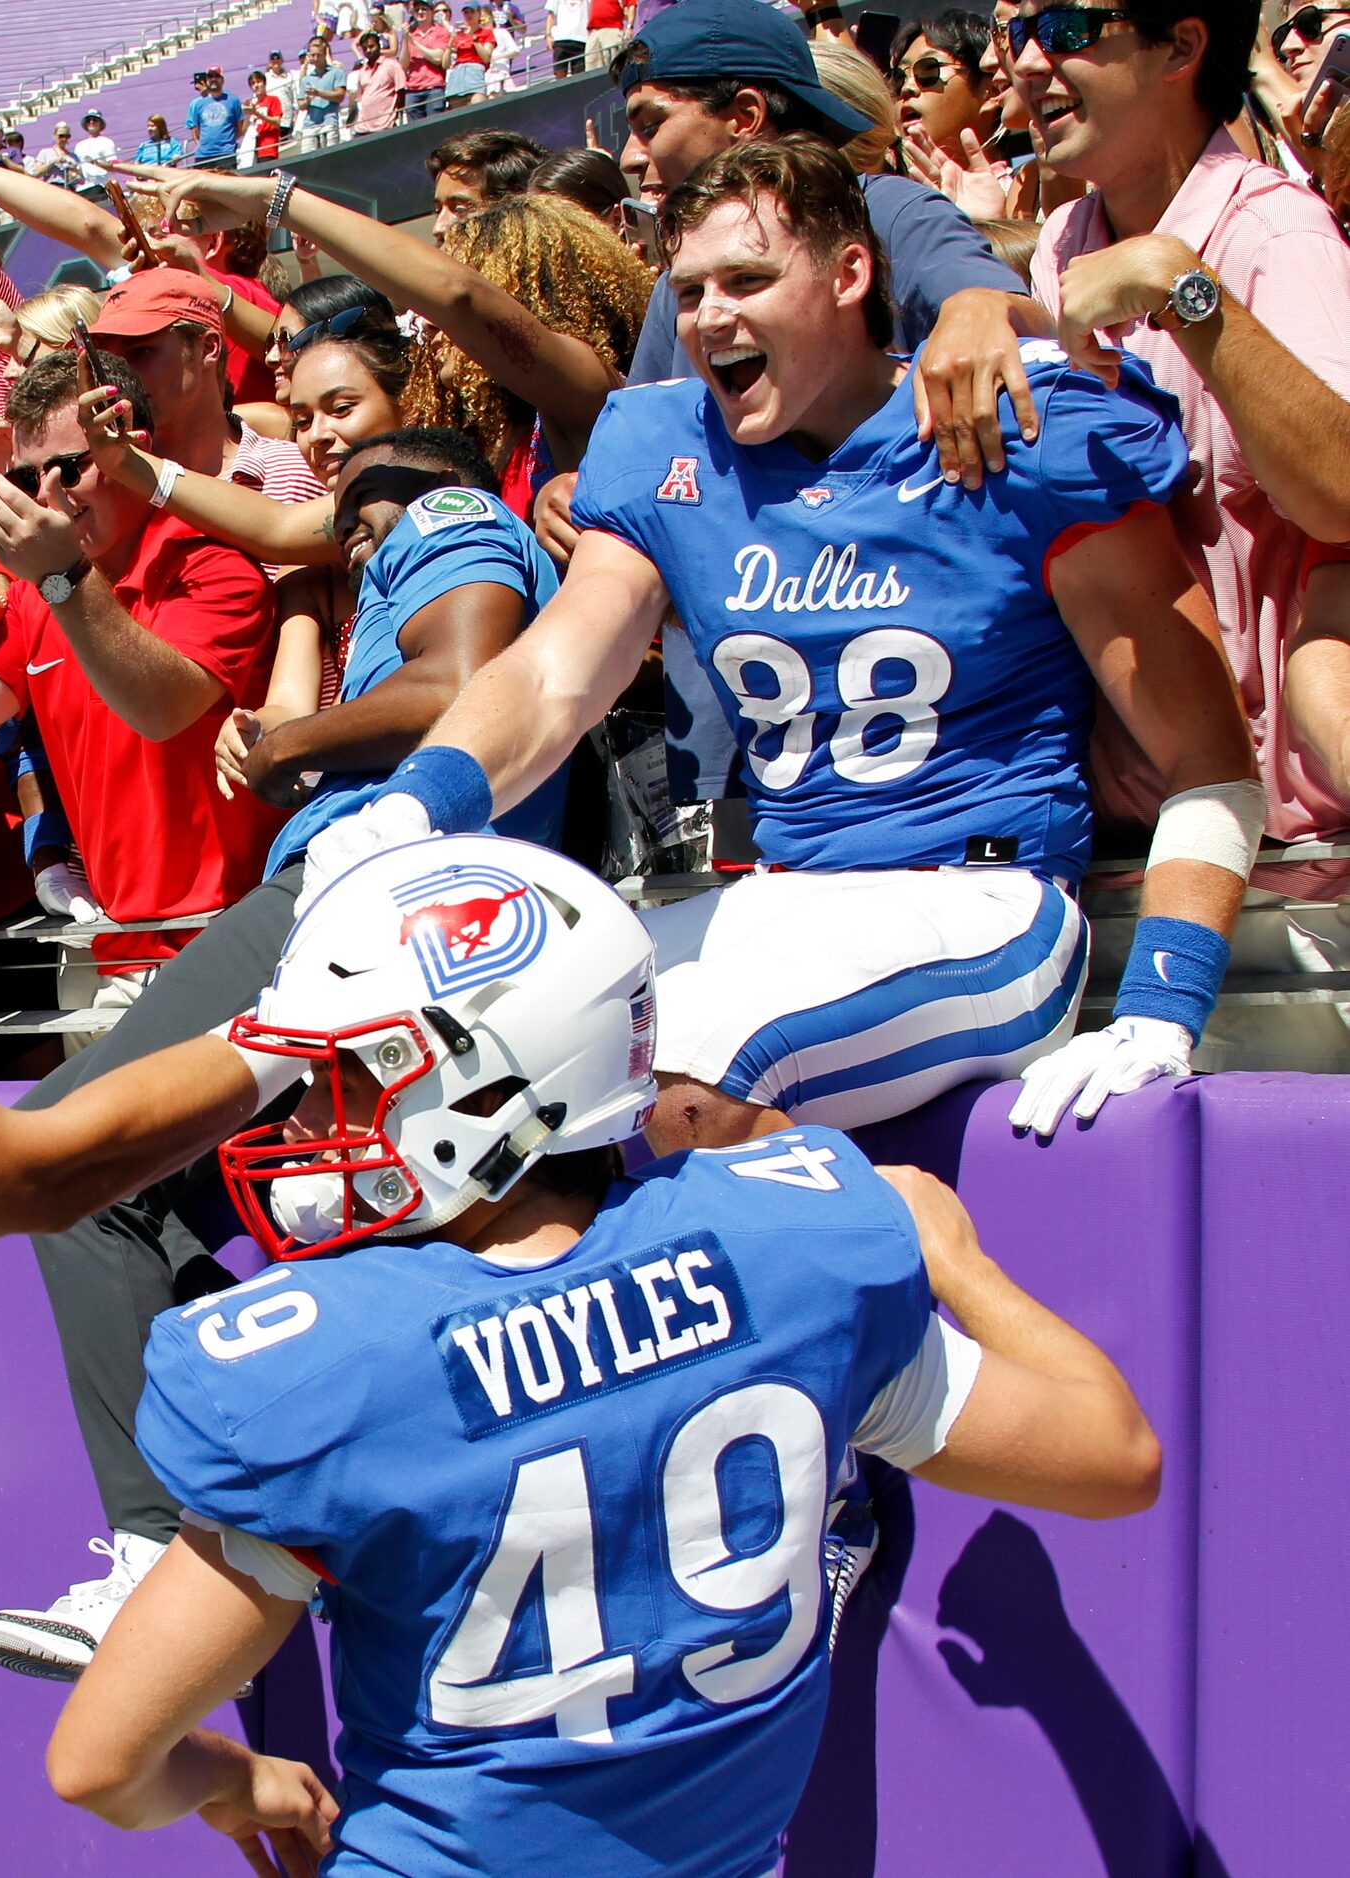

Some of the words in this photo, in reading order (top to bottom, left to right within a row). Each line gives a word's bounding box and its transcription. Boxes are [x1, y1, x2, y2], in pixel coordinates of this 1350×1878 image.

[725, 544, 910, 613] Dallas
[712, 628, 952, 790] 88
[984, 842, 998, 857] L
[452, 1249, 732, 1418] VOYLES
[430, 1383, 827, 1744] 49
